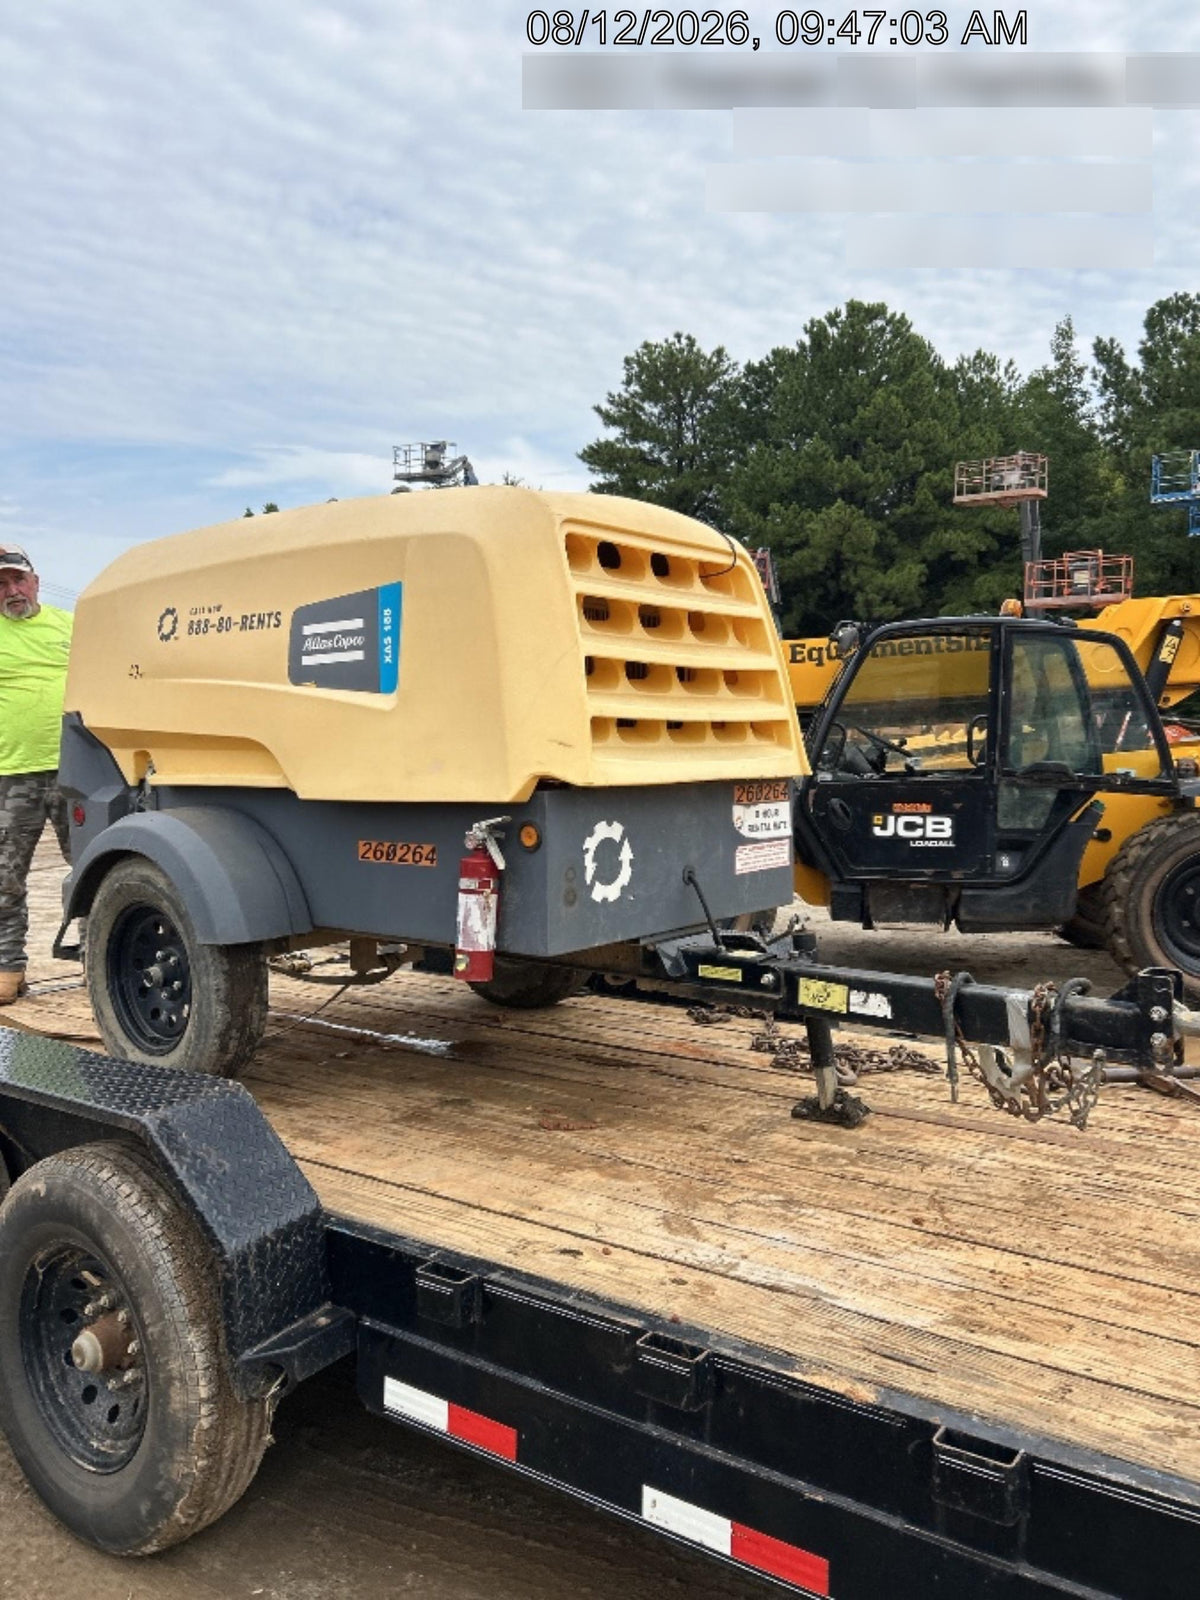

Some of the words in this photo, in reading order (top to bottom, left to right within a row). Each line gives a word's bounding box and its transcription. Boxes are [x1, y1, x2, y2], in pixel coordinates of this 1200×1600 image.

[187, 611, 282, 636] 888-80-RENTS
[383, 636, 393, 664] XAS
[789, 636, 991, 667] EqumentSh
[736, 782, 789, 803] 260264
[872, 815, 953, 839] JCB
[360, 841, 437, 865] 260264
